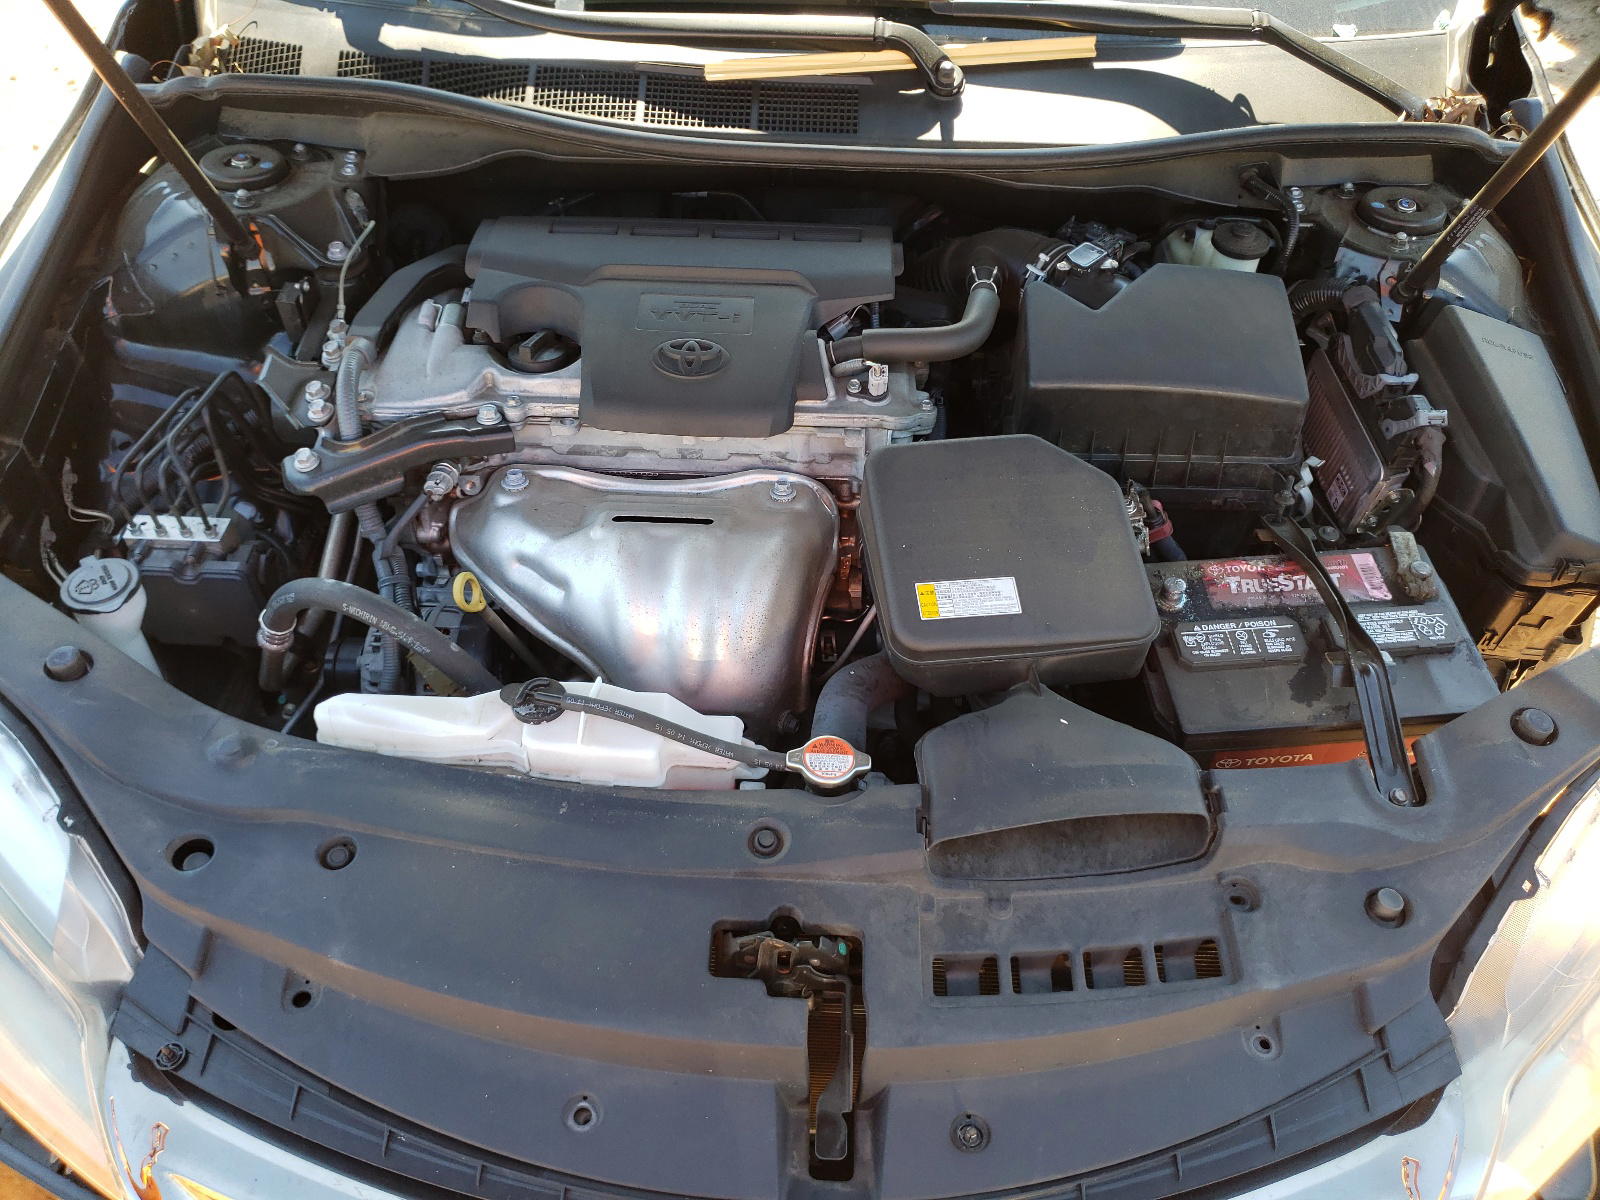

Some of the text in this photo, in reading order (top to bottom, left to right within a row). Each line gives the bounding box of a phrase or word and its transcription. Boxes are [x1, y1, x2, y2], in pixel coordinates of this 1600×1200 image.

[1202, 622, 1237, 631] DANGER
[1244, 619, 1277, 627] POISON
[1246, 753, 1314, 766] TOYOTA
